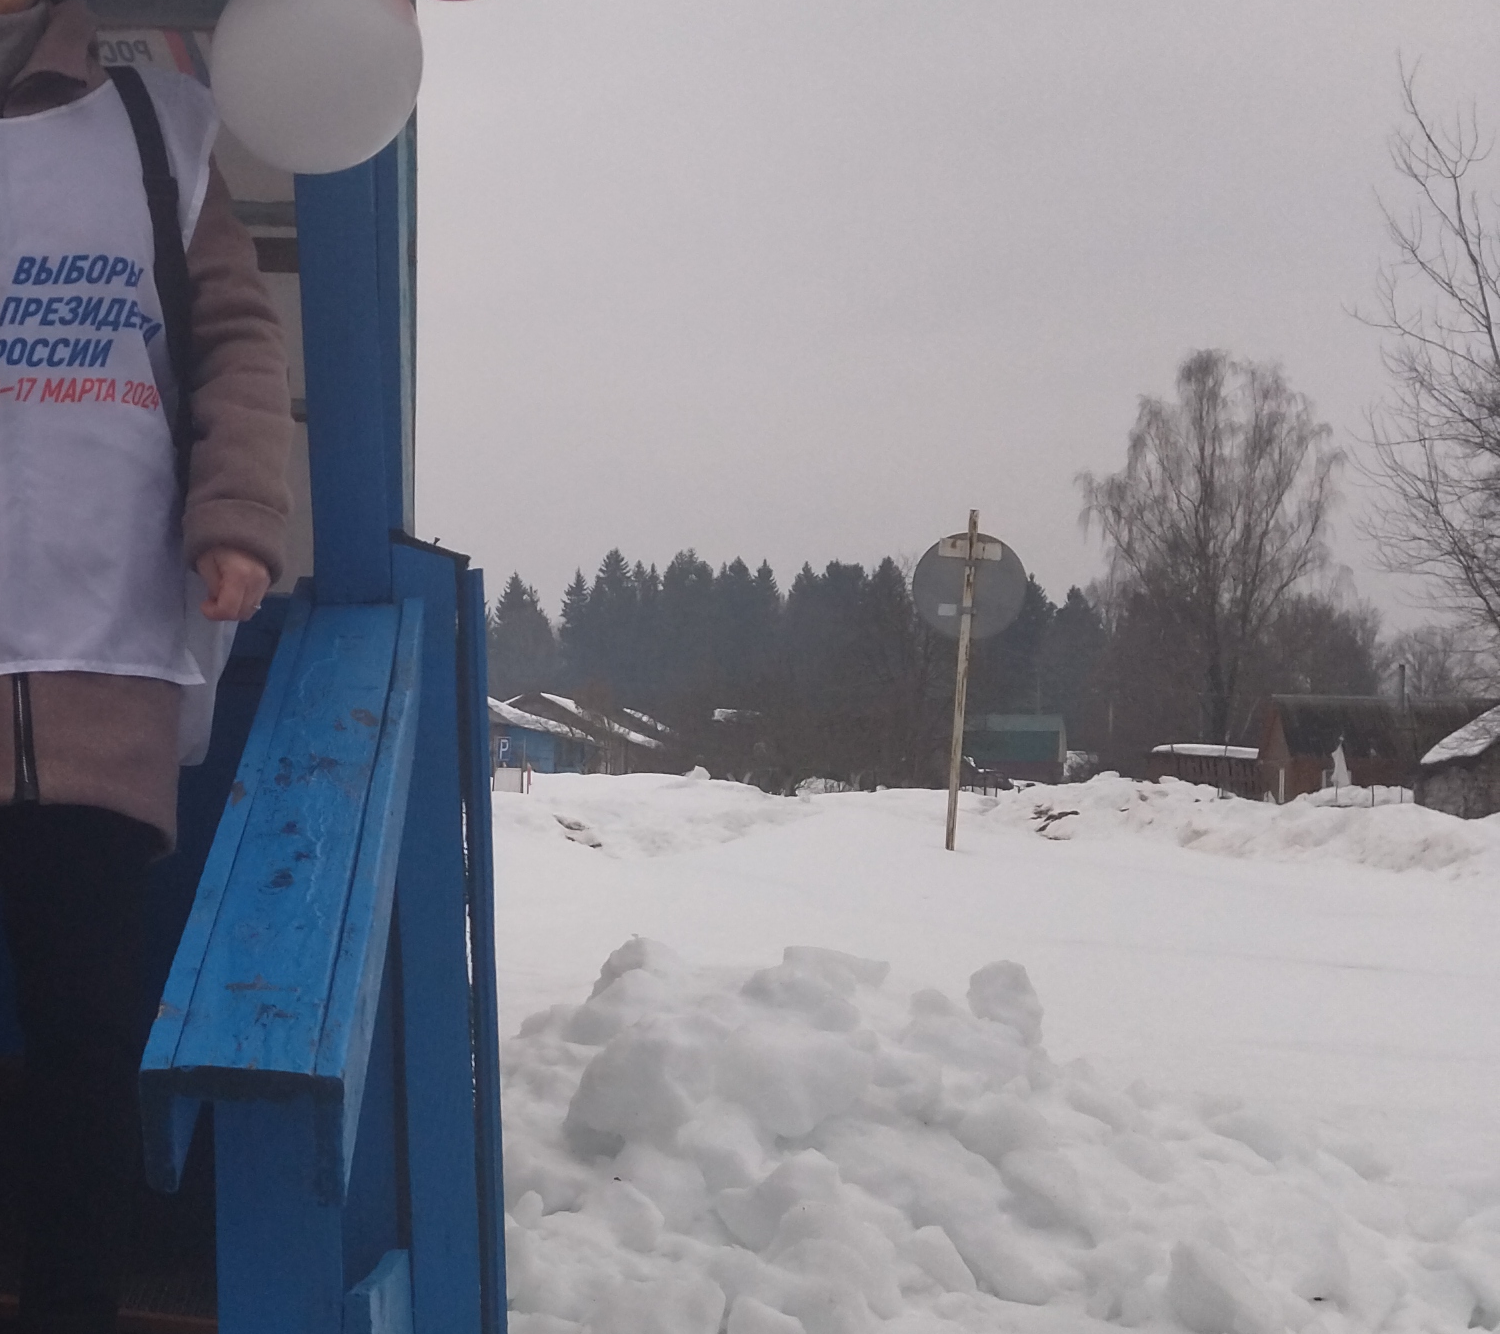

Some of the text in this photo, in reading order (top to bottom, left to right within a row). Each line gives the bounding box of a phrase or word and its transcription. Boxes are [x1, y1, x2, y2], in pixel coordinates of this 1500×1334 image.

[12, 254, 144, 287] ВЫБОРЫ
[40, 378, 116, 403] МАРТА
[499, 739, 509, 760] P
